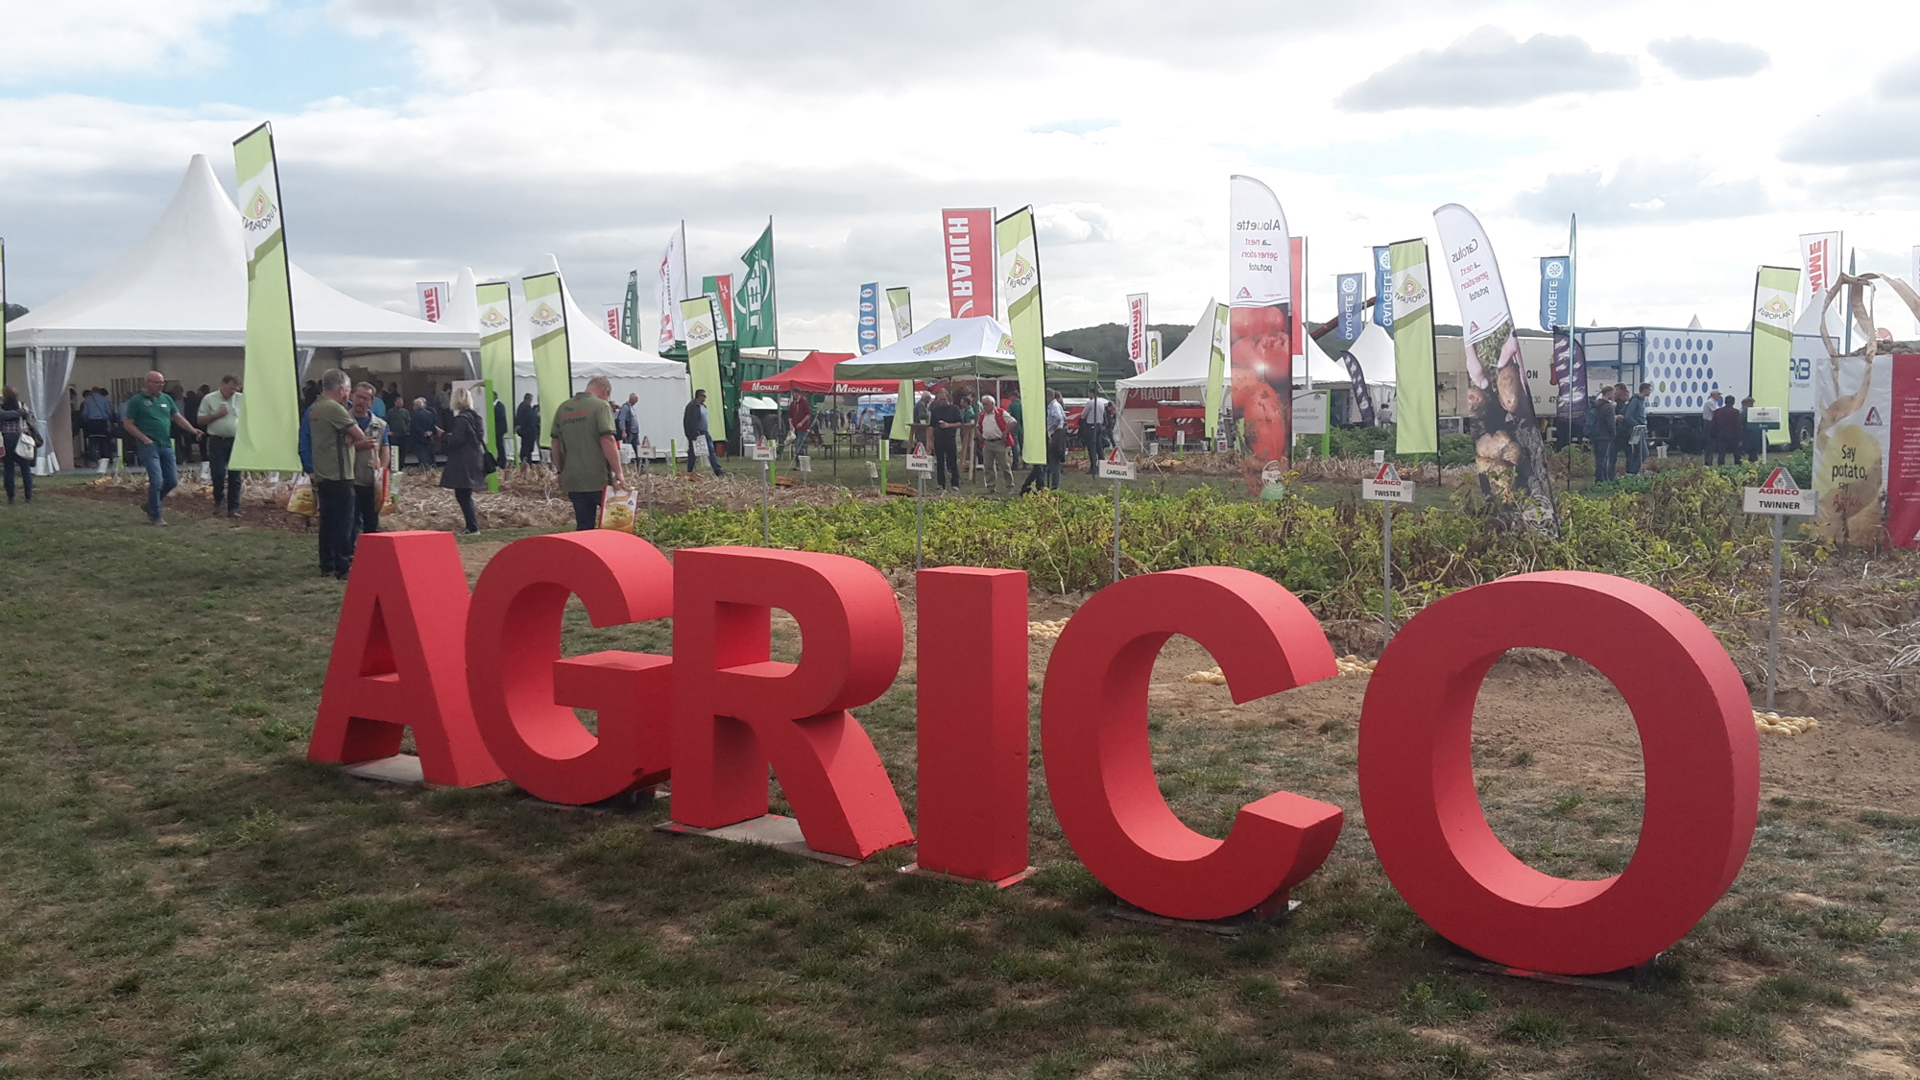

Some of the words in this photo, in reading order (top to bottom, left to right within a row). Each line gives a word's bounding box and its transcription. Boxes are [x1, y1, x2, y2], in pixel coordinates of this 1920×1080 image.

[1757, 307, 1794, 320] EUROPLANT
[752, 382, 781, 391] MICHALEK
[835, 383, 883, 393] MICHALEK
[1841, 444, 1856, 462] Say
[1106, 468, 1128, 476] CAROLUS
[1831, 462, 1868, 482] potato,
[1758, 488, 1800, 496] AGRICO
[1838, 482, 1849, 492] say
[1374, 489, 1401, 498] TWISTER
[1758, 500, 1801, 510] TWINNER
[307, 529, 1760, 976] AGRICO
